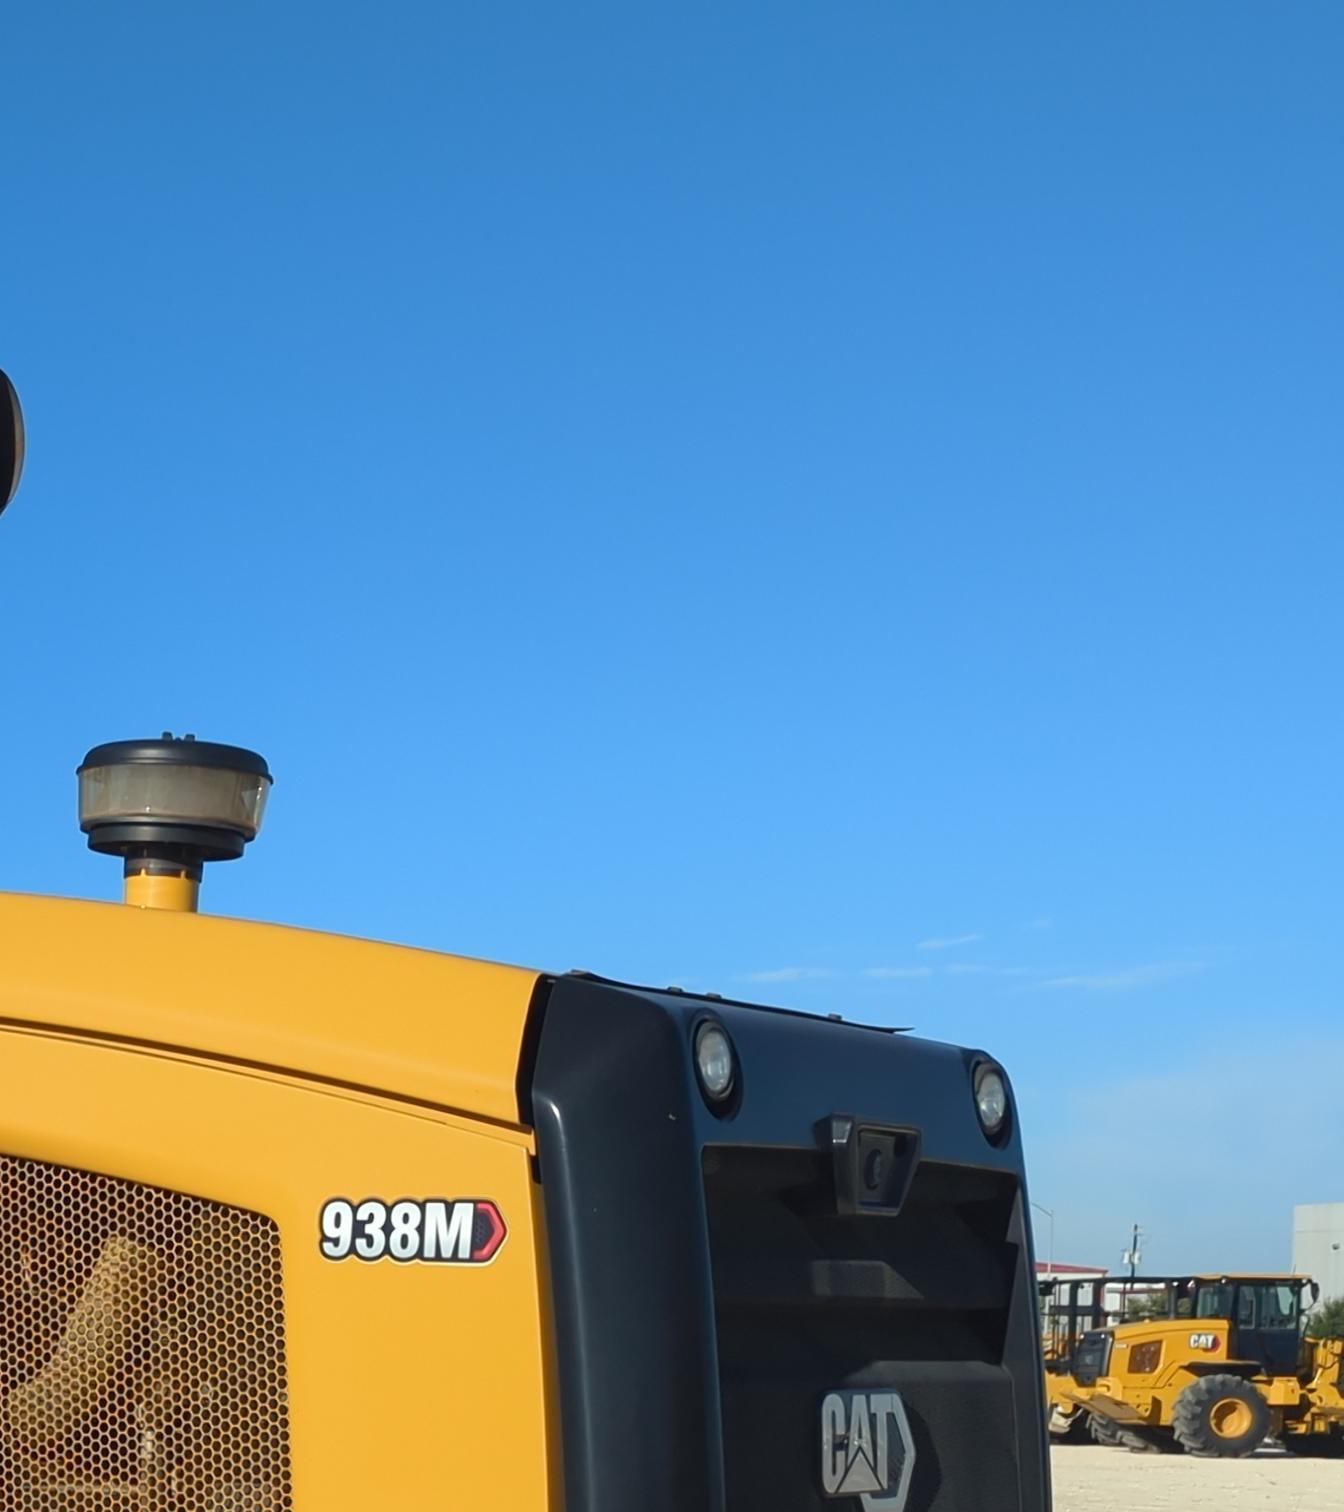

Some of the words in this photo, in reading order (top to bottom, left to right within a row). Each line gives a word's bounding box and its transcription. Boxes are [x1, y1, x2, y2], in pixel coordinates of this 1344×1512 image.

[321, 1200, 475, 1260] 938M
[1190, 1334, 1214, 1349] CAT
[821, 1392, 895, 1495] CAT
